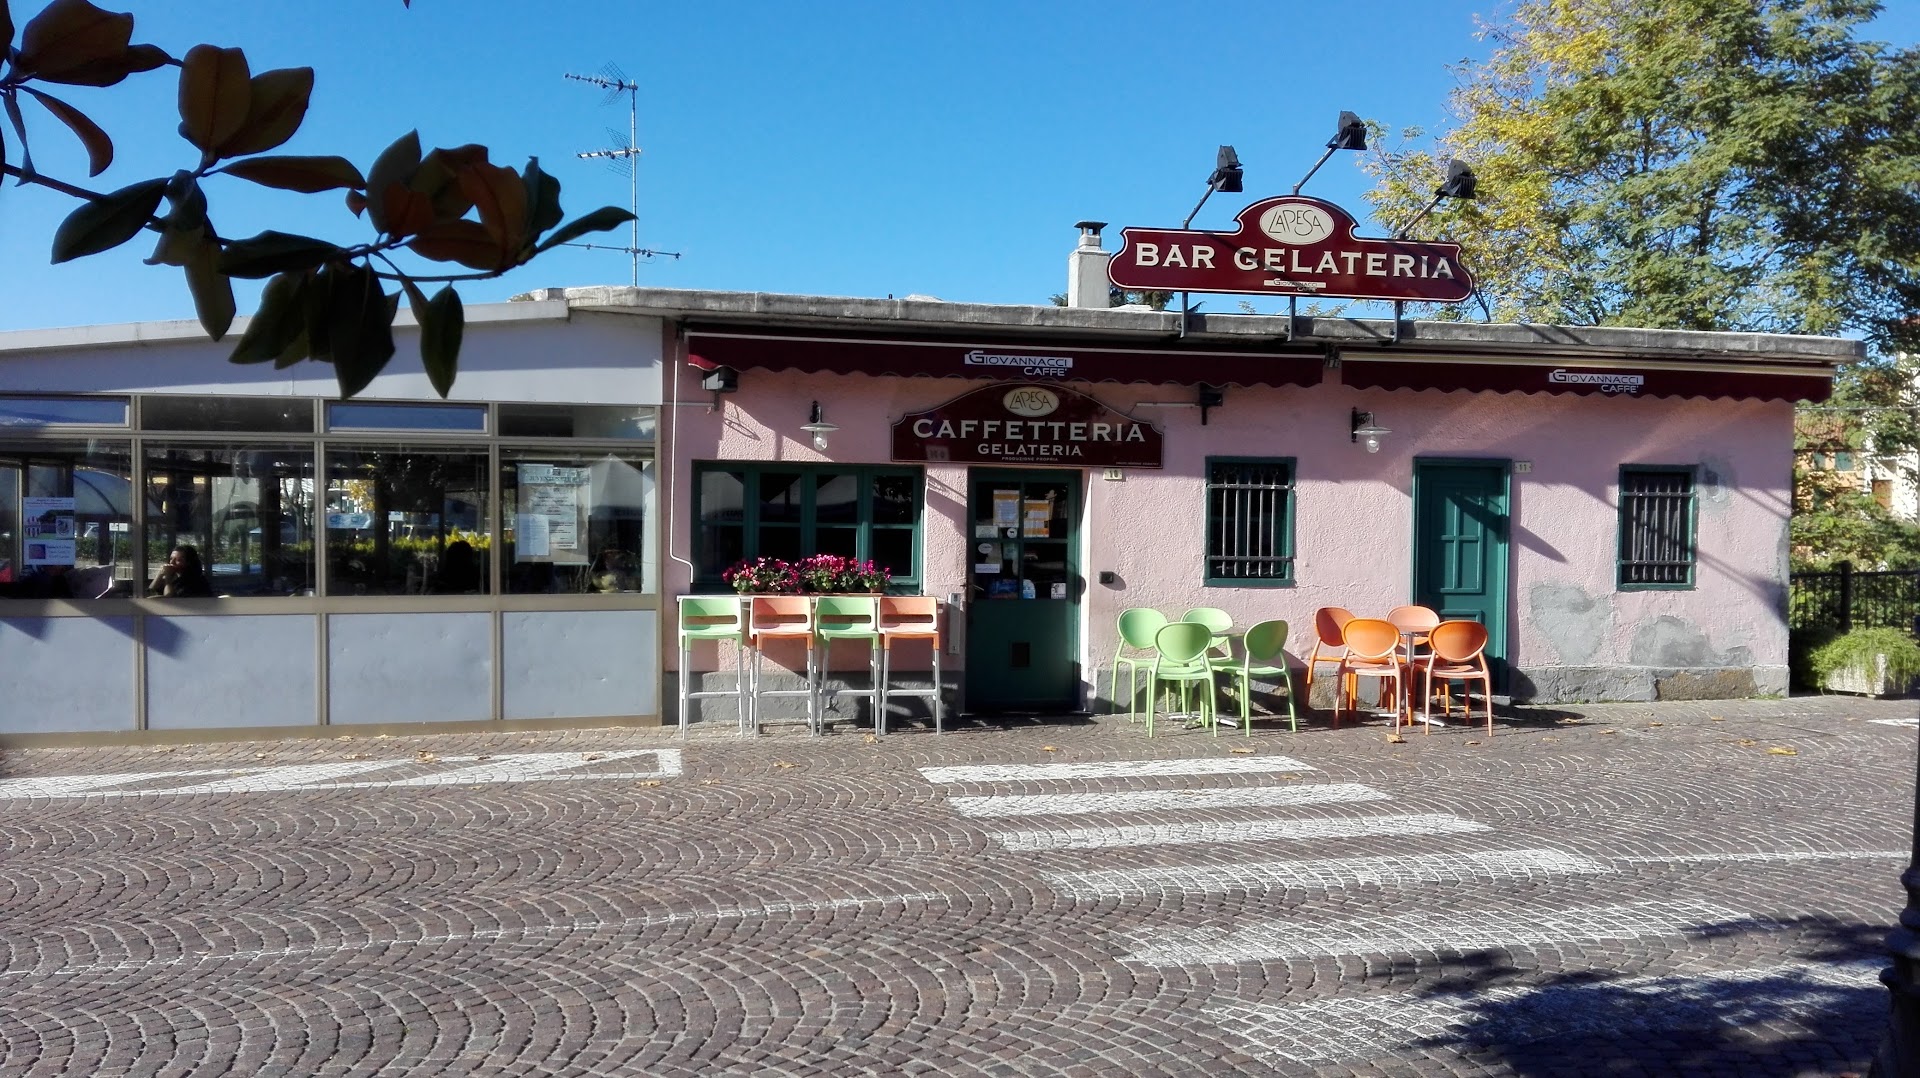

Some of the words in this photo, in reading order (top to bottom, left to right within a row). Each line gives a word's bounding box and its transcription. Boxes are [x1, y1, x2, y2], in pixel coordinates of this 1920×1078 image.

[1135, 242, 1216, 269] BAR
[1233, 246, 1456, 280] GELATERIA
[968, 350, 1067, 367] GIOVANNACCI
[1023, 367, 1068, 377] CAFFE'
[1552, 369, 1639, 384] GIOVANNACCI
[913, 419, 1146, 443] CAFFETTERIA
[977, 443, 1083, 457] GELATERIA
